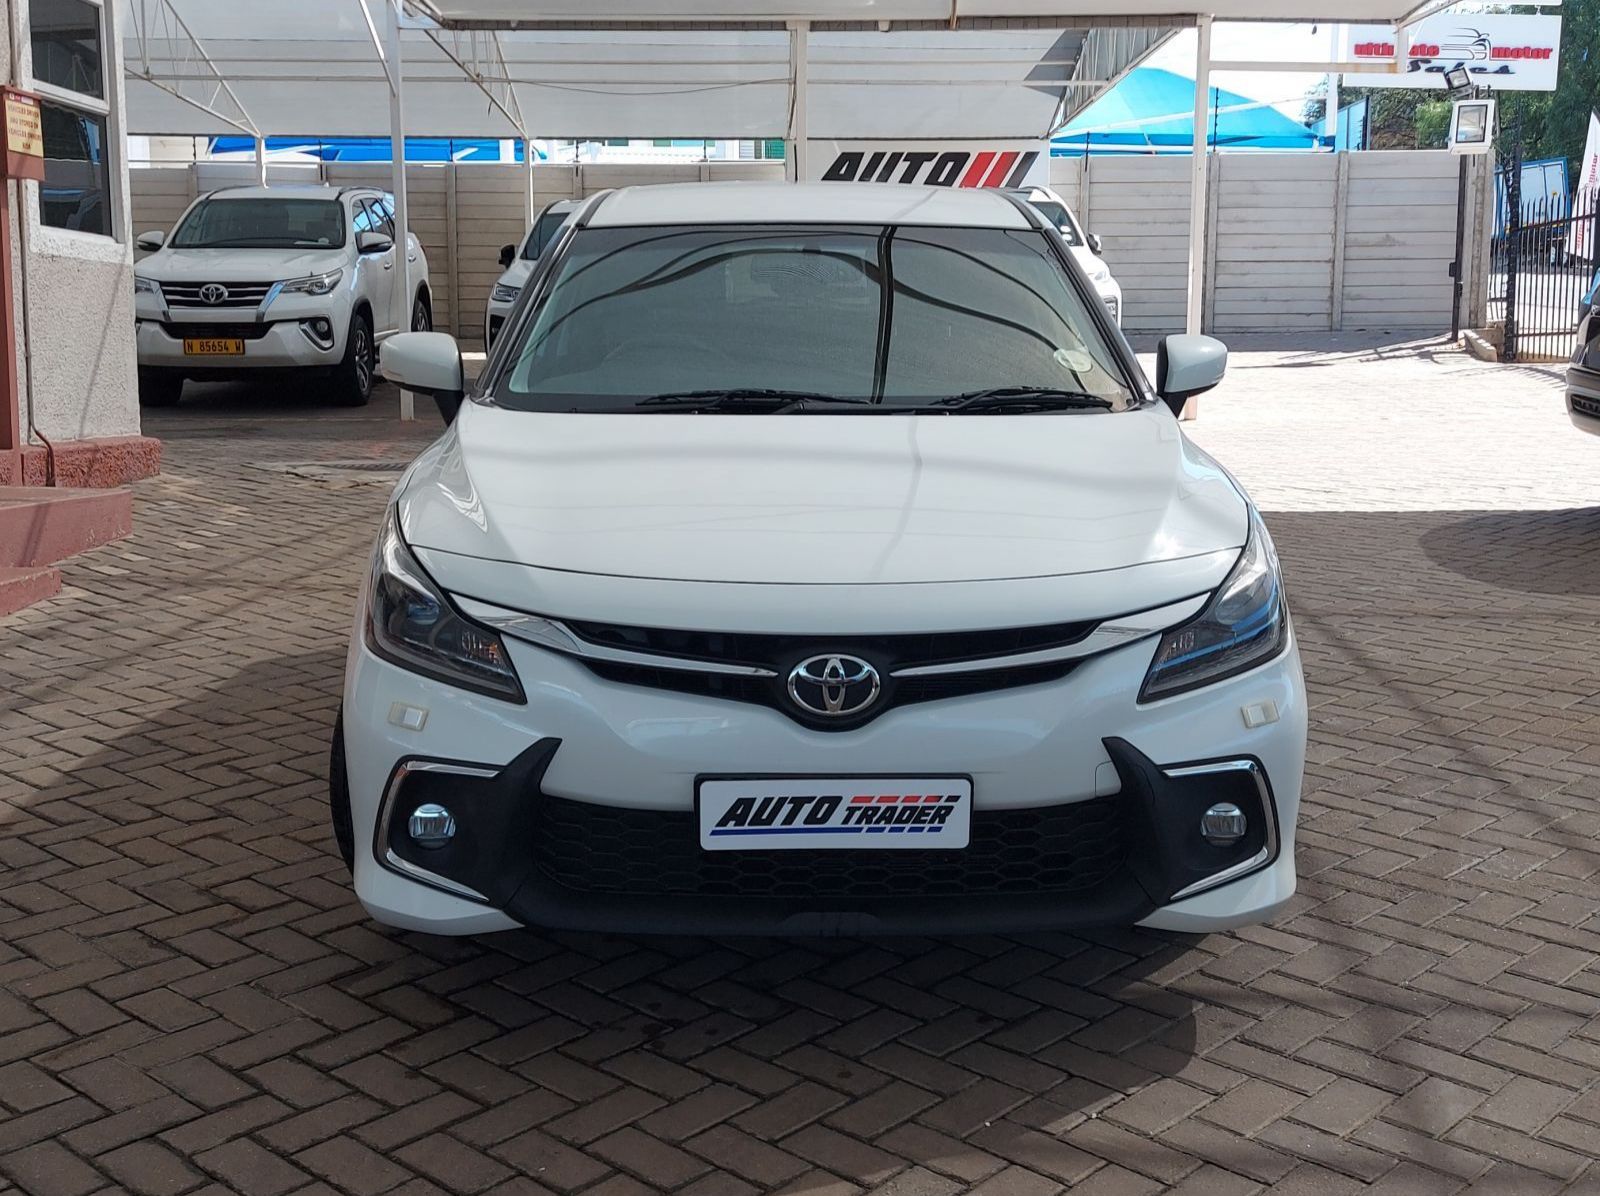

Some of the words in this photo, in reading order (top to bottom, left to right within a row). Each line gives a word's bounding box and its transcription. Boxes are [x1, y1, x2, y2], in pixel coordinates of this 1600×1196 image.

[1491, 46, 1553, 59] motor
[821, 151, 972, 188] AUTO
[186, 341, 194, 353] N
[199, 341, 229, 352] 85654
[234, 340, 241, 352] W
[715, 796, 843, 827] AUTO
[841, 805, 955, 826] TRADER
